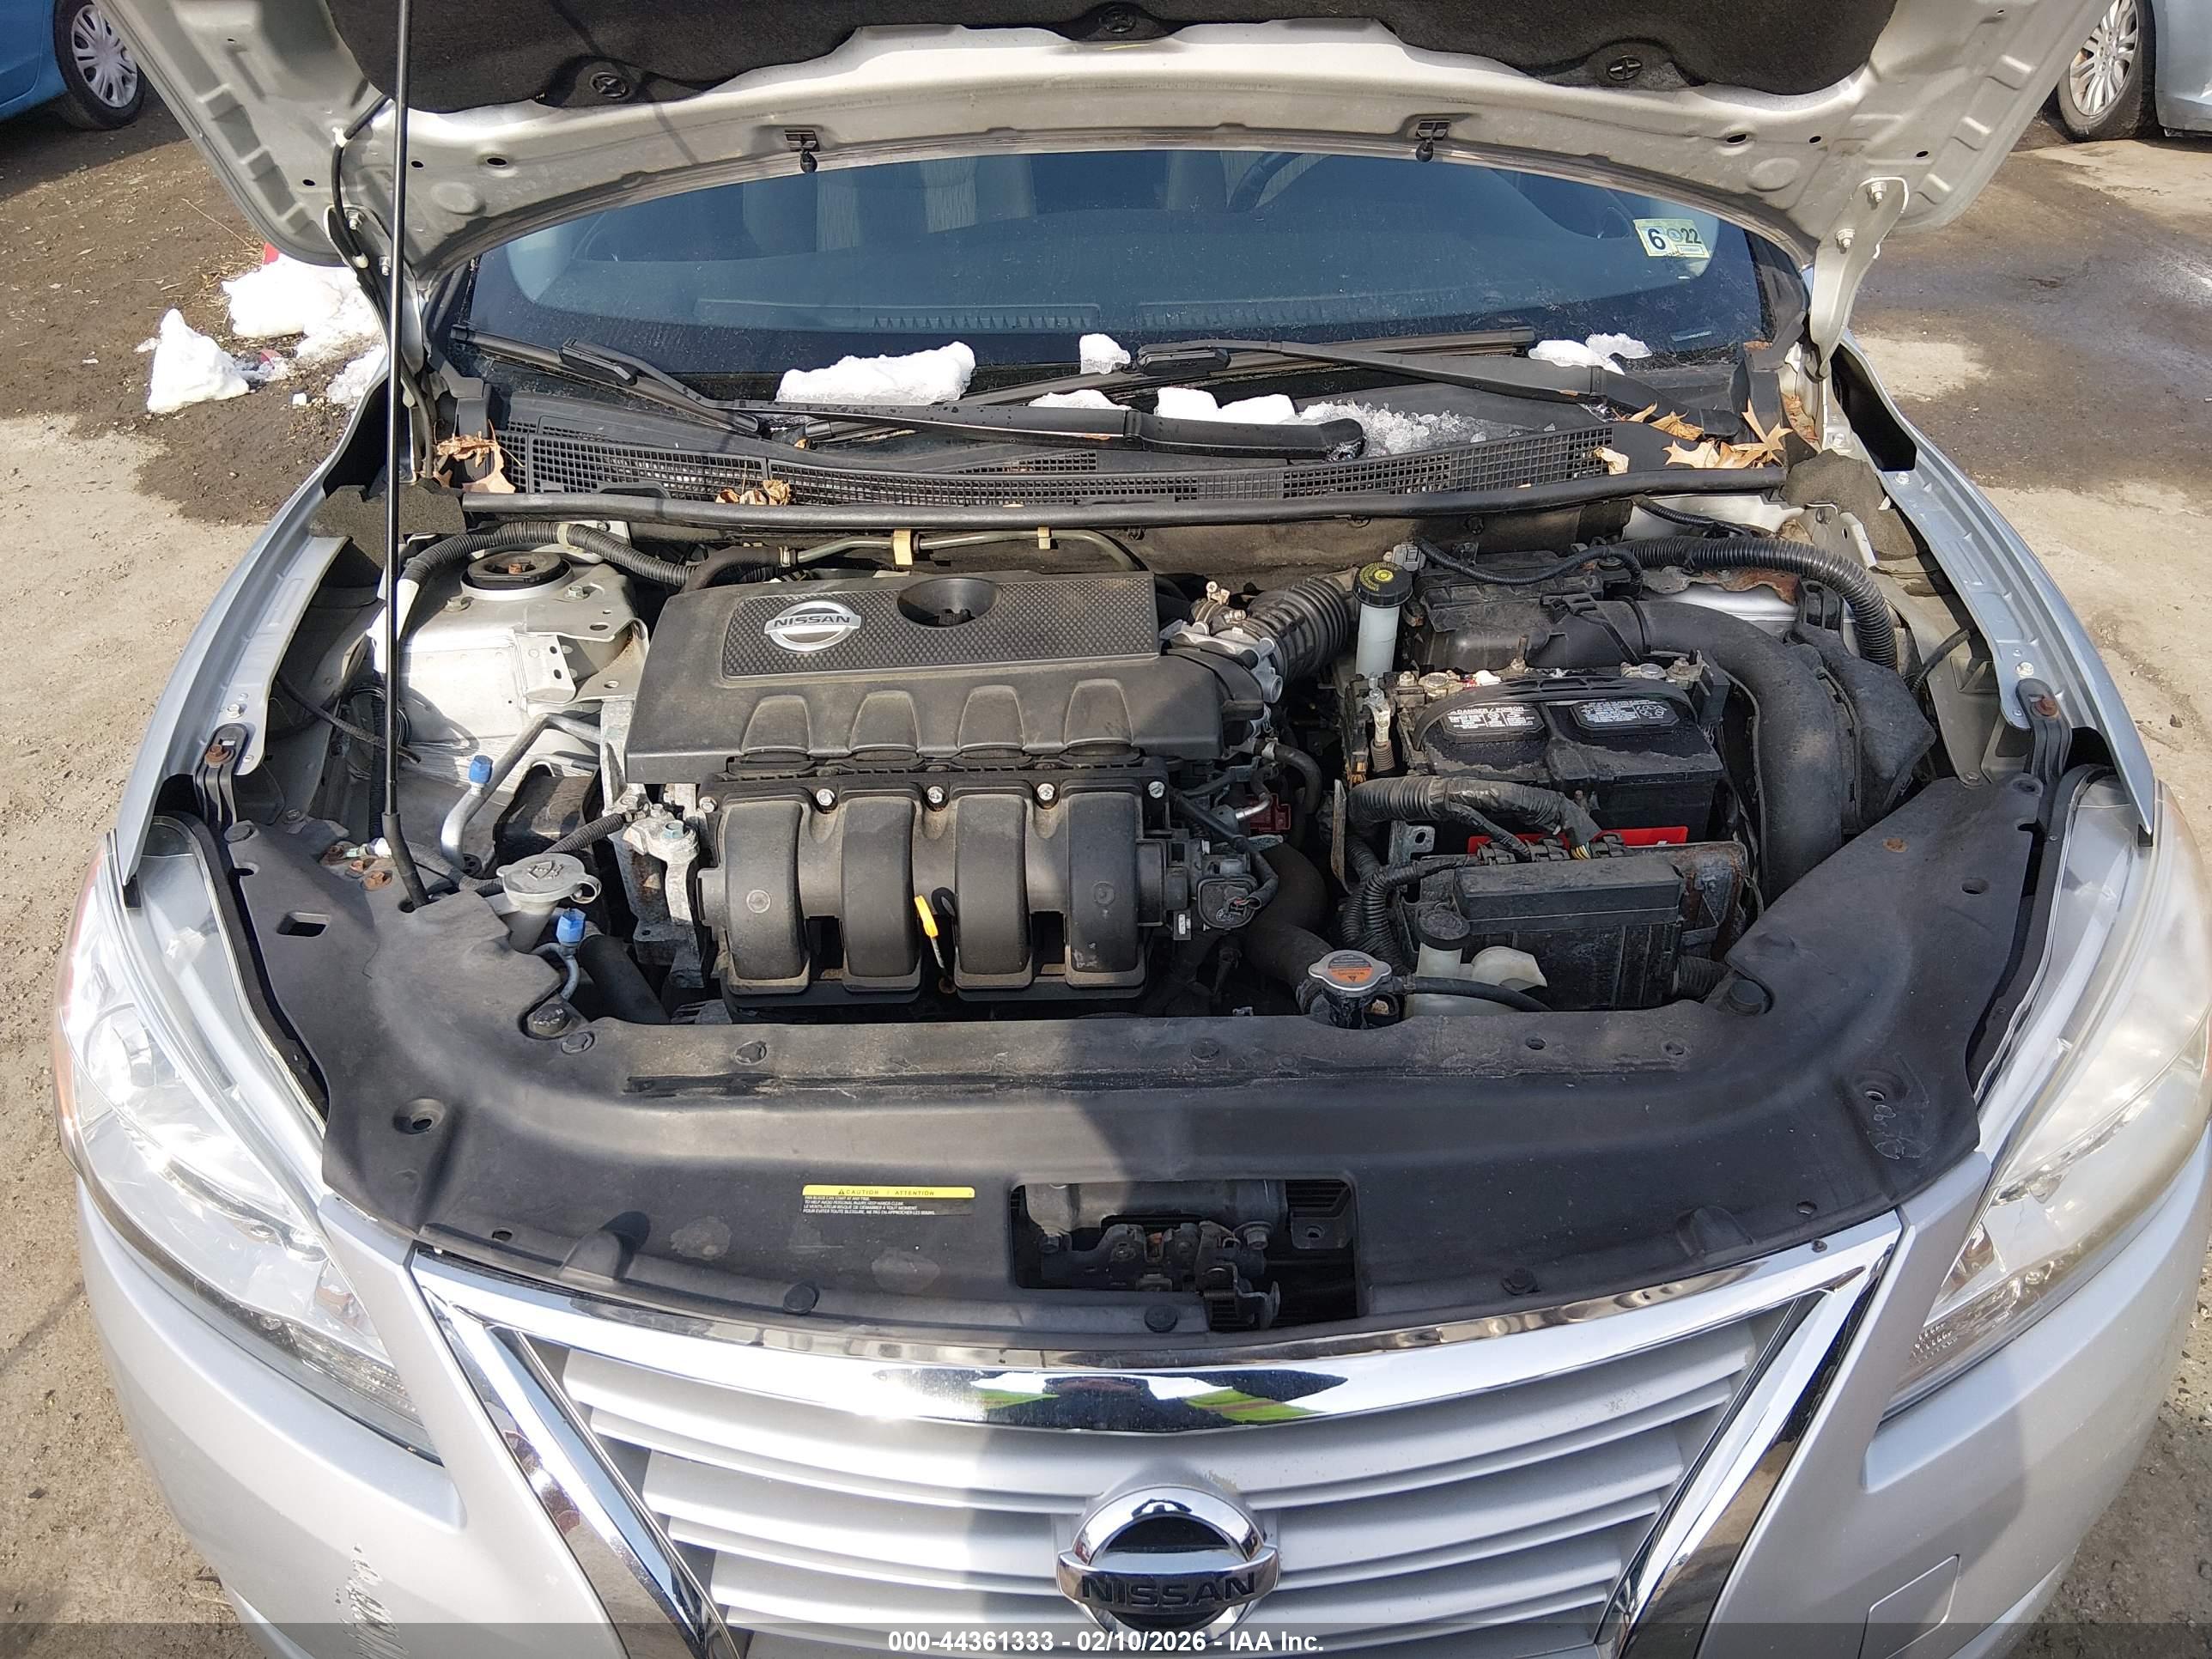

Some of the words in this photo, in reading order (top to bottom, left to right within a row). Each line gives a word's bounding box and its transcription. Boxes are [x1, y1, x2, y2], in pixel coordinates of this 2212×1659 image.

[1647, 228, 1666, 250] 6
[1680, 228, 1702, 244] 22
[774, 615, 851, 628] NISSAN
[1082, 1572, 1255, 1607] NISSAN
